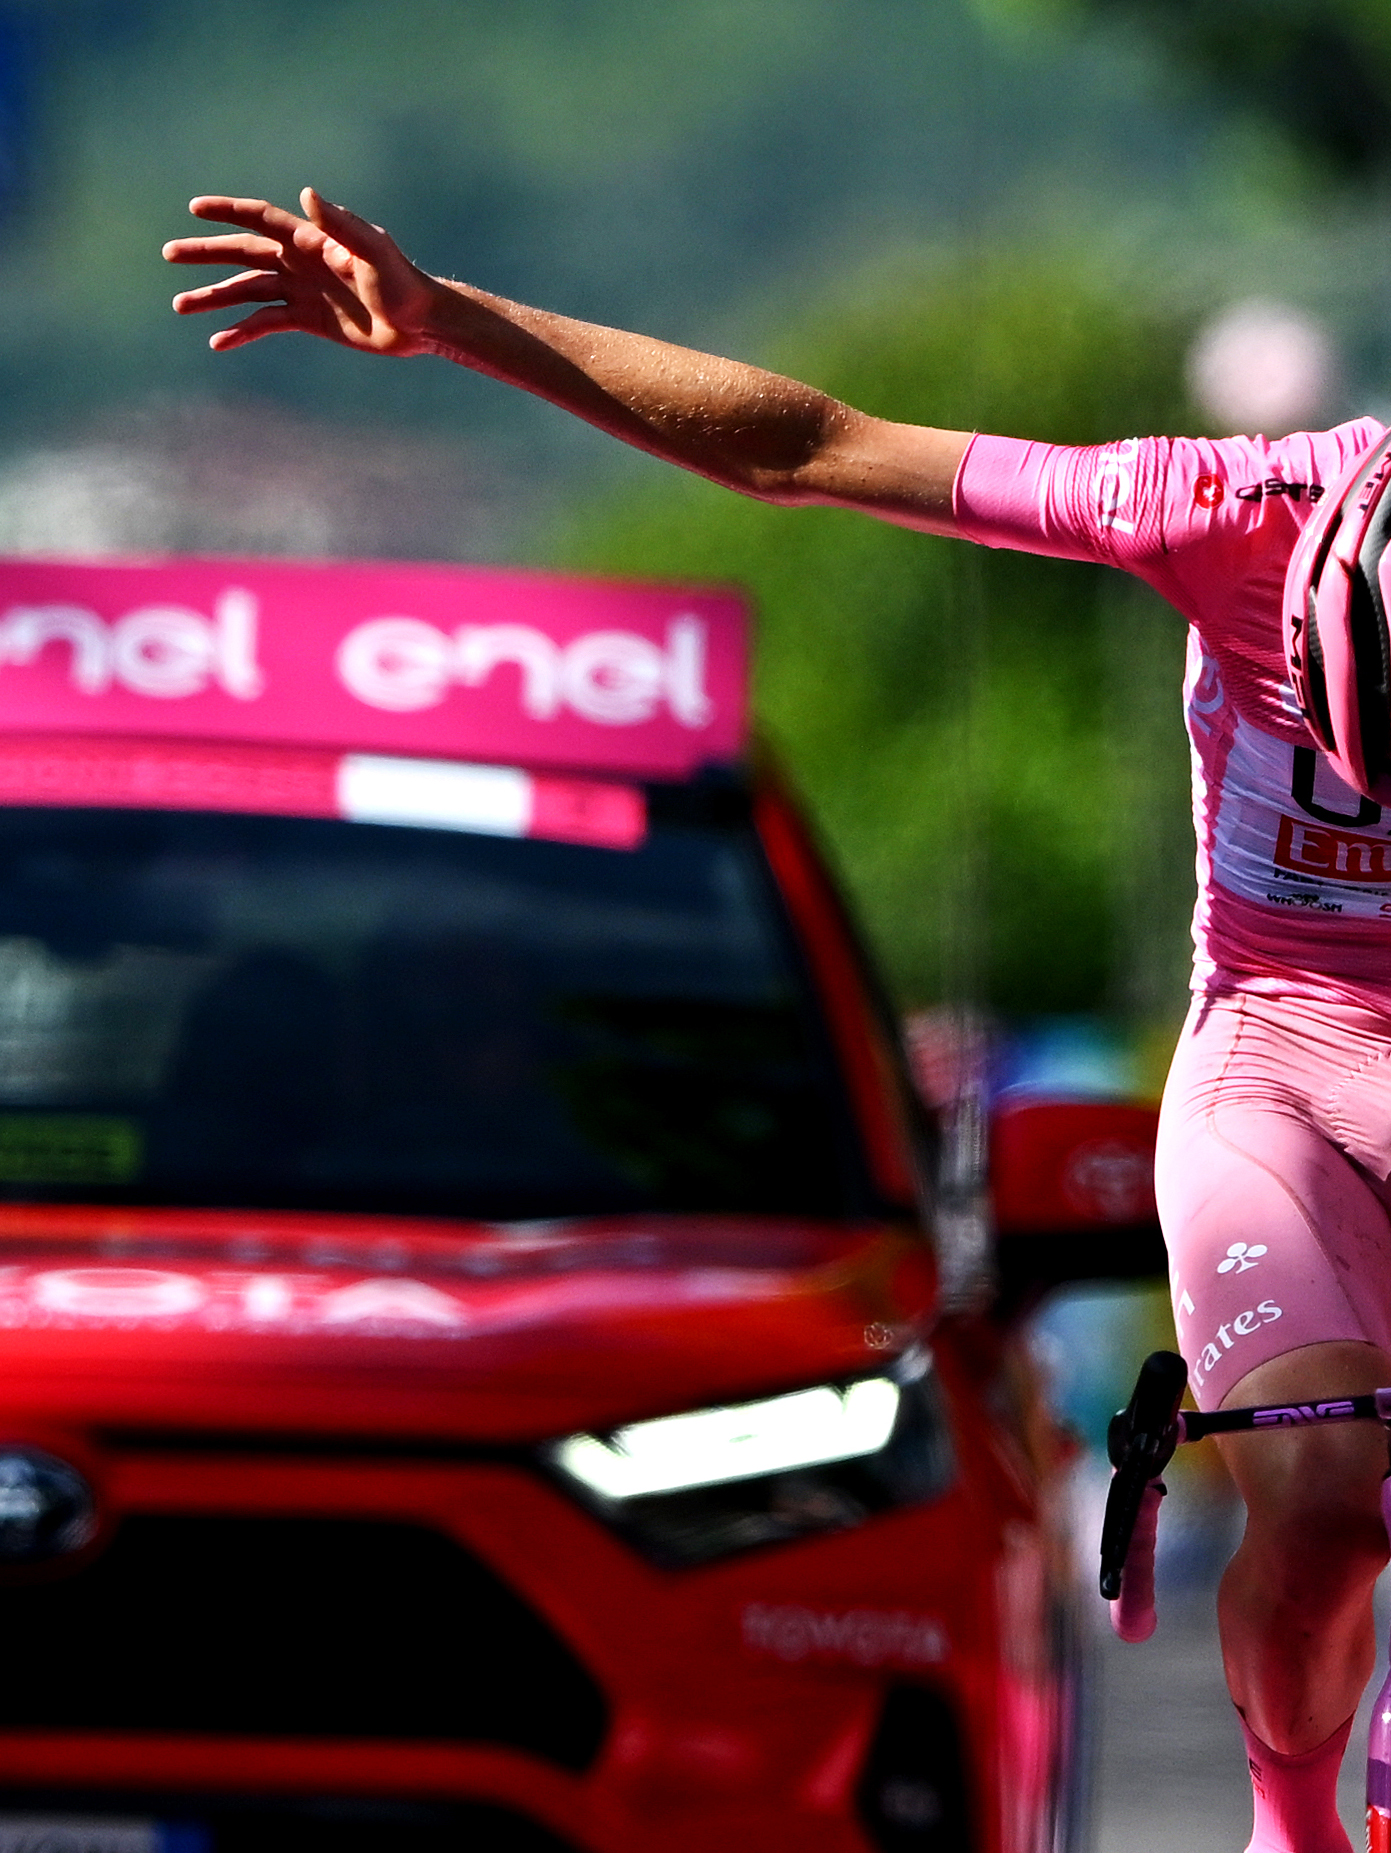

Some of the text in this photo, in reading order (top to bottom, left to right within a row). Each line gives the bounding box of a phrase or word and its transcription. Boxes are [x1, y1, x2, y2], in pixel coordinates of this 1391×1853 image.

[1235, 477, 1327, 505] CASTE
[0, 587, 264, 701] nel
[335, 613, 713, 728] enel
[0, 1266, 468, 1328] OTA
[1193, 1299, 1284, 1387] rates
[742, 1603, 949, 1666] TOYOTA
